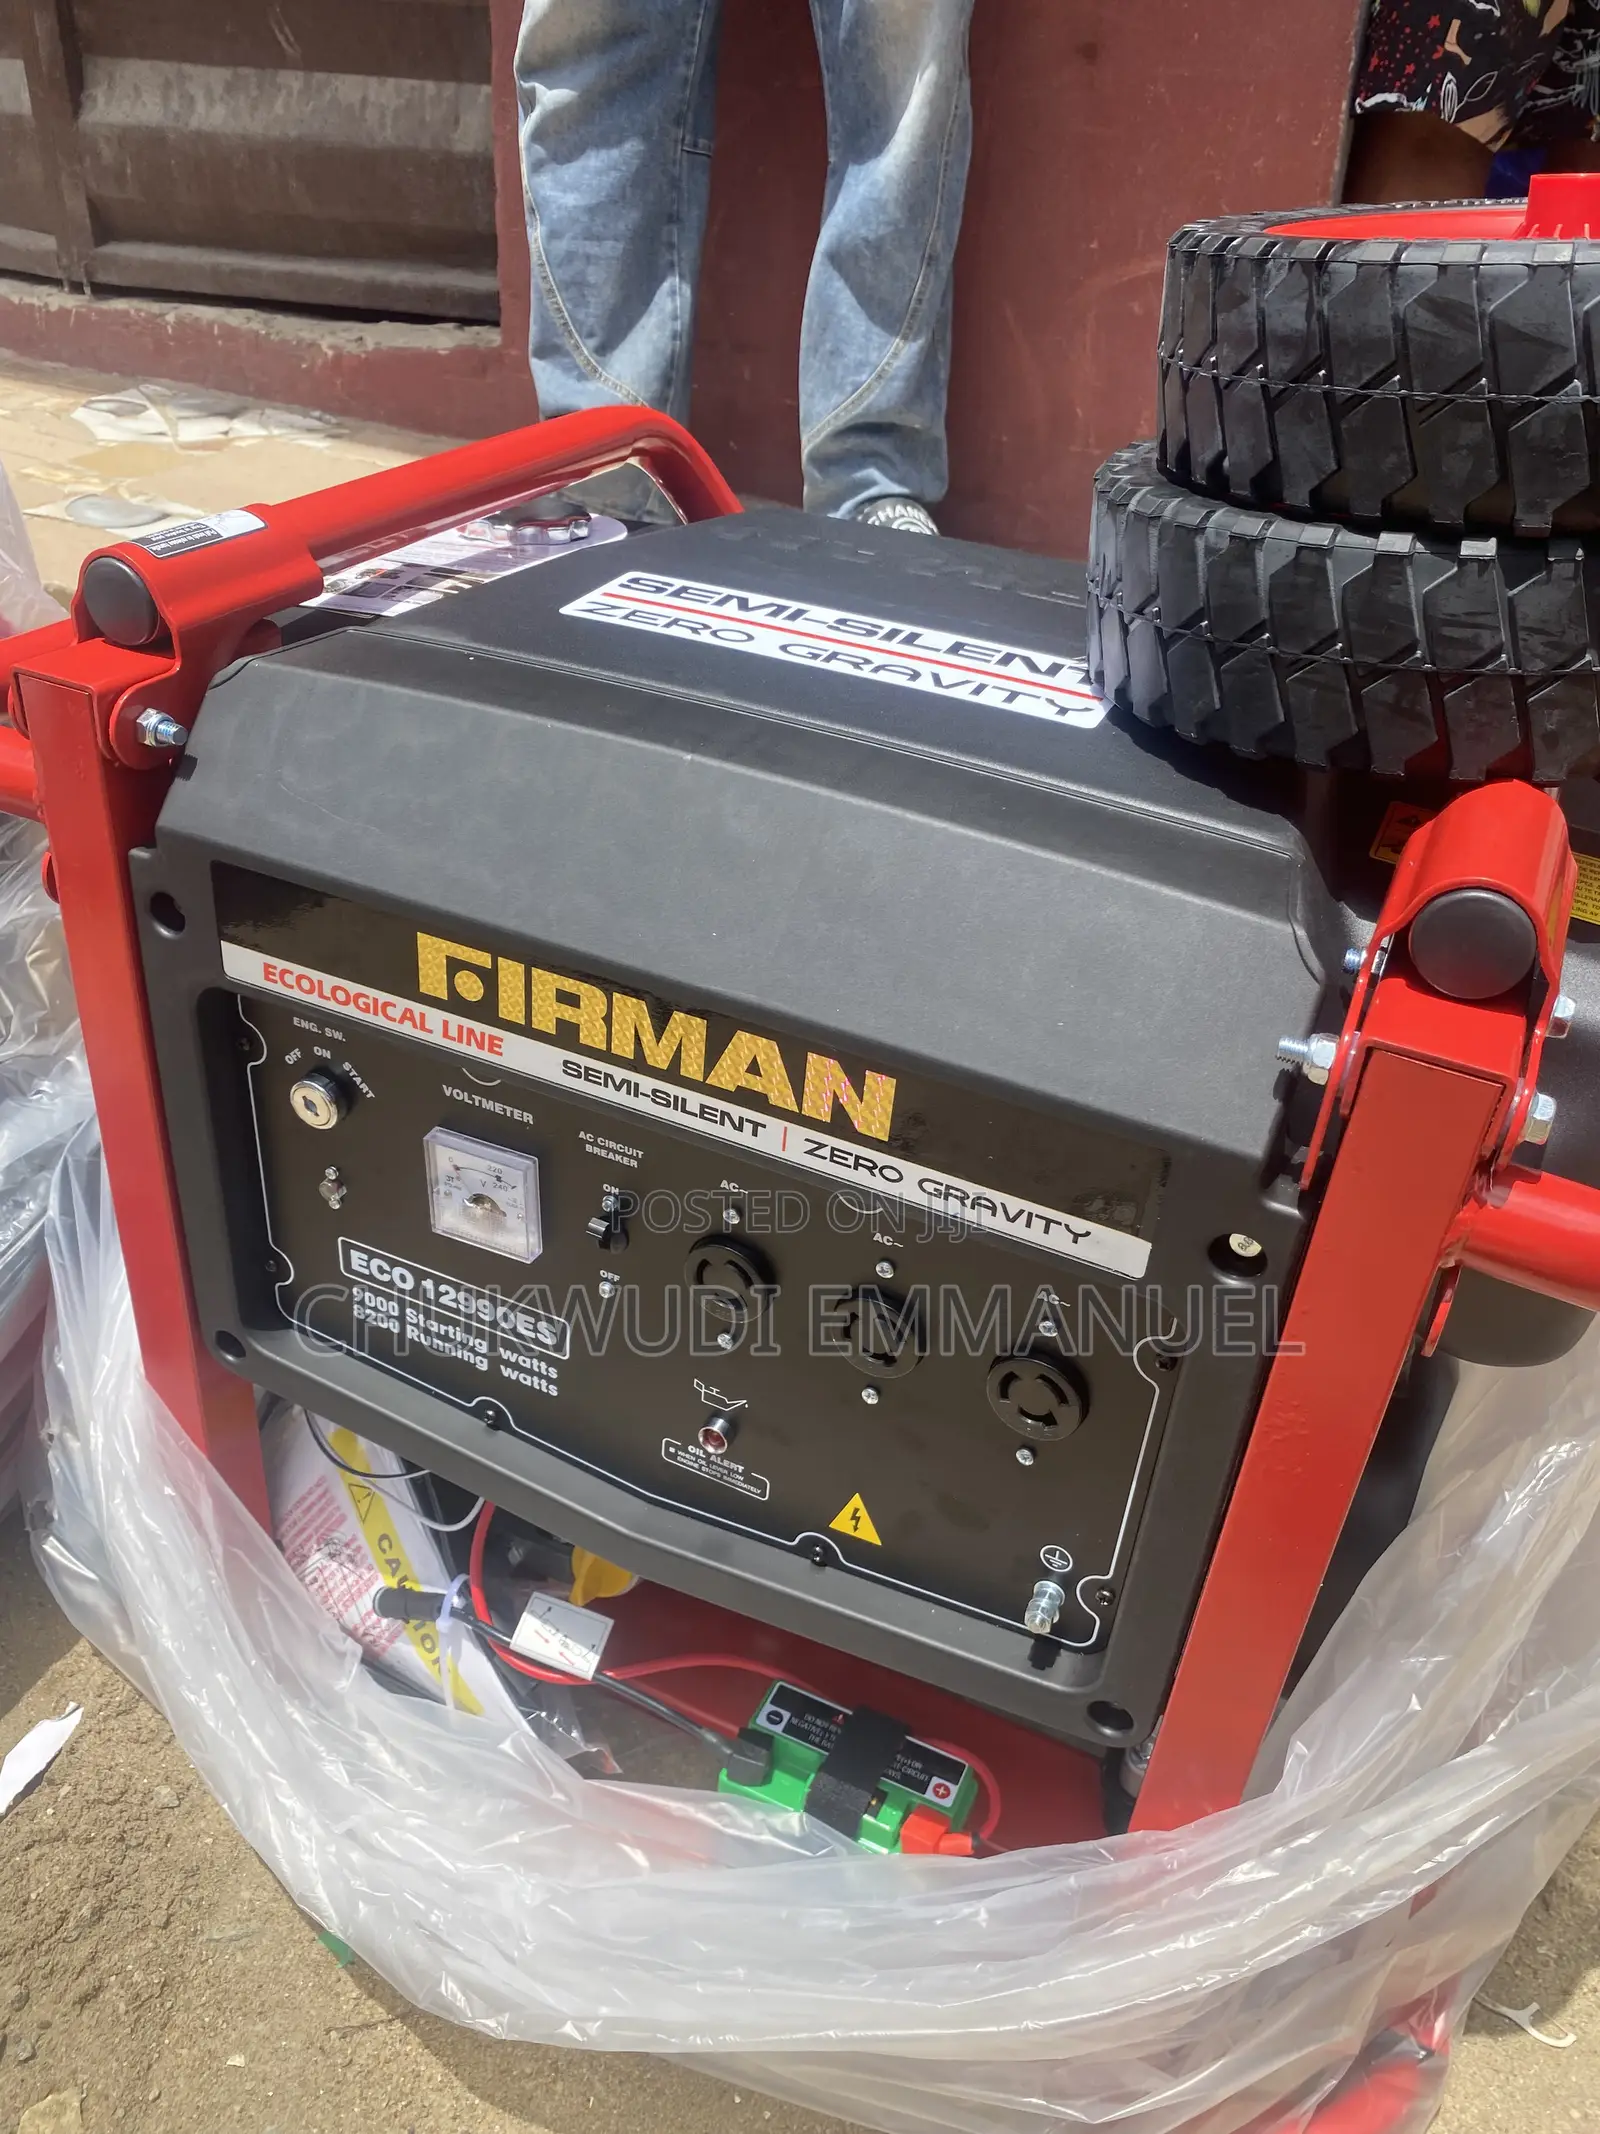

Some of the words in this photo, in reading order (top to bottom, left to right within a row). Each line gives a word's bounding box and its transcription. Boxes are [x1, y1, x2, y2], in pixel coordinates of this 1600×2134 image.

[617, 575, 1094, 685] SEMI-SILENT
[574, 600, 755, 644] ZERO
[778, 642, 1095, 717] GRAVITY
[262, 962, 434, 1034] ECOLOGICAL
[442, 1018, 504, 1057] LINE
[293, 1016, 322, 1034] ENG.
[324, 1027, 346, 1042] SW.
[313, 1046, 331, 1060] ON
[416, 931, 897, 1142] FIRMAN
[284, 1048, 302, 1065] OFF
[342, 1061, 375, 1098] START
[442, 1084, 535, 1125] VOLTMETER
[562, 1058, 767, 1138] SEMI-SILENT
[803, 1137, 904, 1183] ZERO
[917, 1177, 1092, 1244] GRAVITY
[578, 1131, 595, 1142] AC
[597, 1137, 644, 1159] CIRCUIT
[585, 1143, 638, 1168] BREAKER
[602, 1183, 620, 1195] ON
[600, 1269, 621, 1282] OFF
[349, 1248, 415, 1291] ECO
[421, 1278, 558, 1346] 12990ES
[352, 1287, 400, 1317] 9000
[405, 1306, 488, 1355] Starting
[499, 1347, 558, 1380] watts
[353, 1304, 400, 1334] 8200
[406, 1324, 488, 1372] Running
[500, 1364, 559, 1398] watts
[687, 1445, 706, 1458] OIL
[710, 1455, 744, 1473] ALERT
